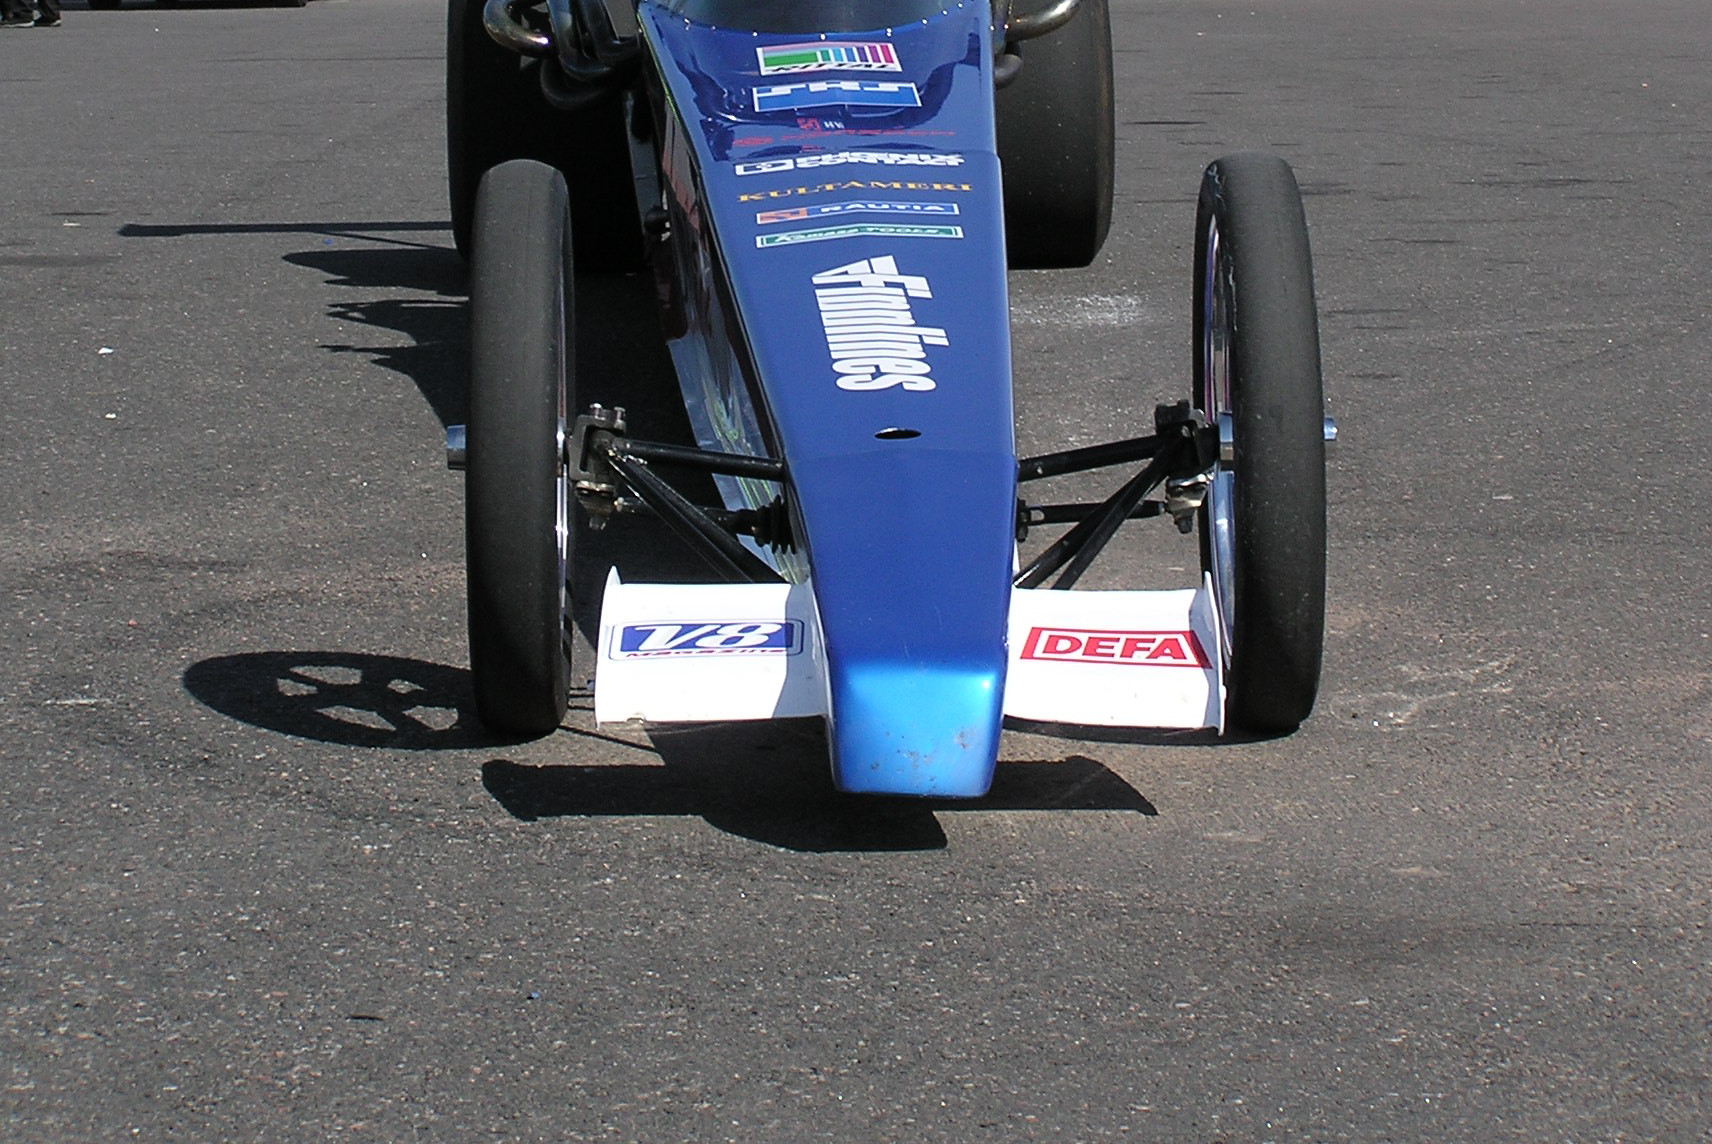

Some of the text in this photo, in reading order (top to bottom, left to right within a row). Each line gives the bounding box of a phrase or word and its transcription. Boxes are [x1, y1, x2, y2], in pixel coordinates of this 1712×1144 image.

[738, 180, 972, 203] KULTAMERI
[820, 203, 945, 213] RAUTIA
[634, 622, 783, 651] V8
[1042, 634, 1187, 660] DEFA
